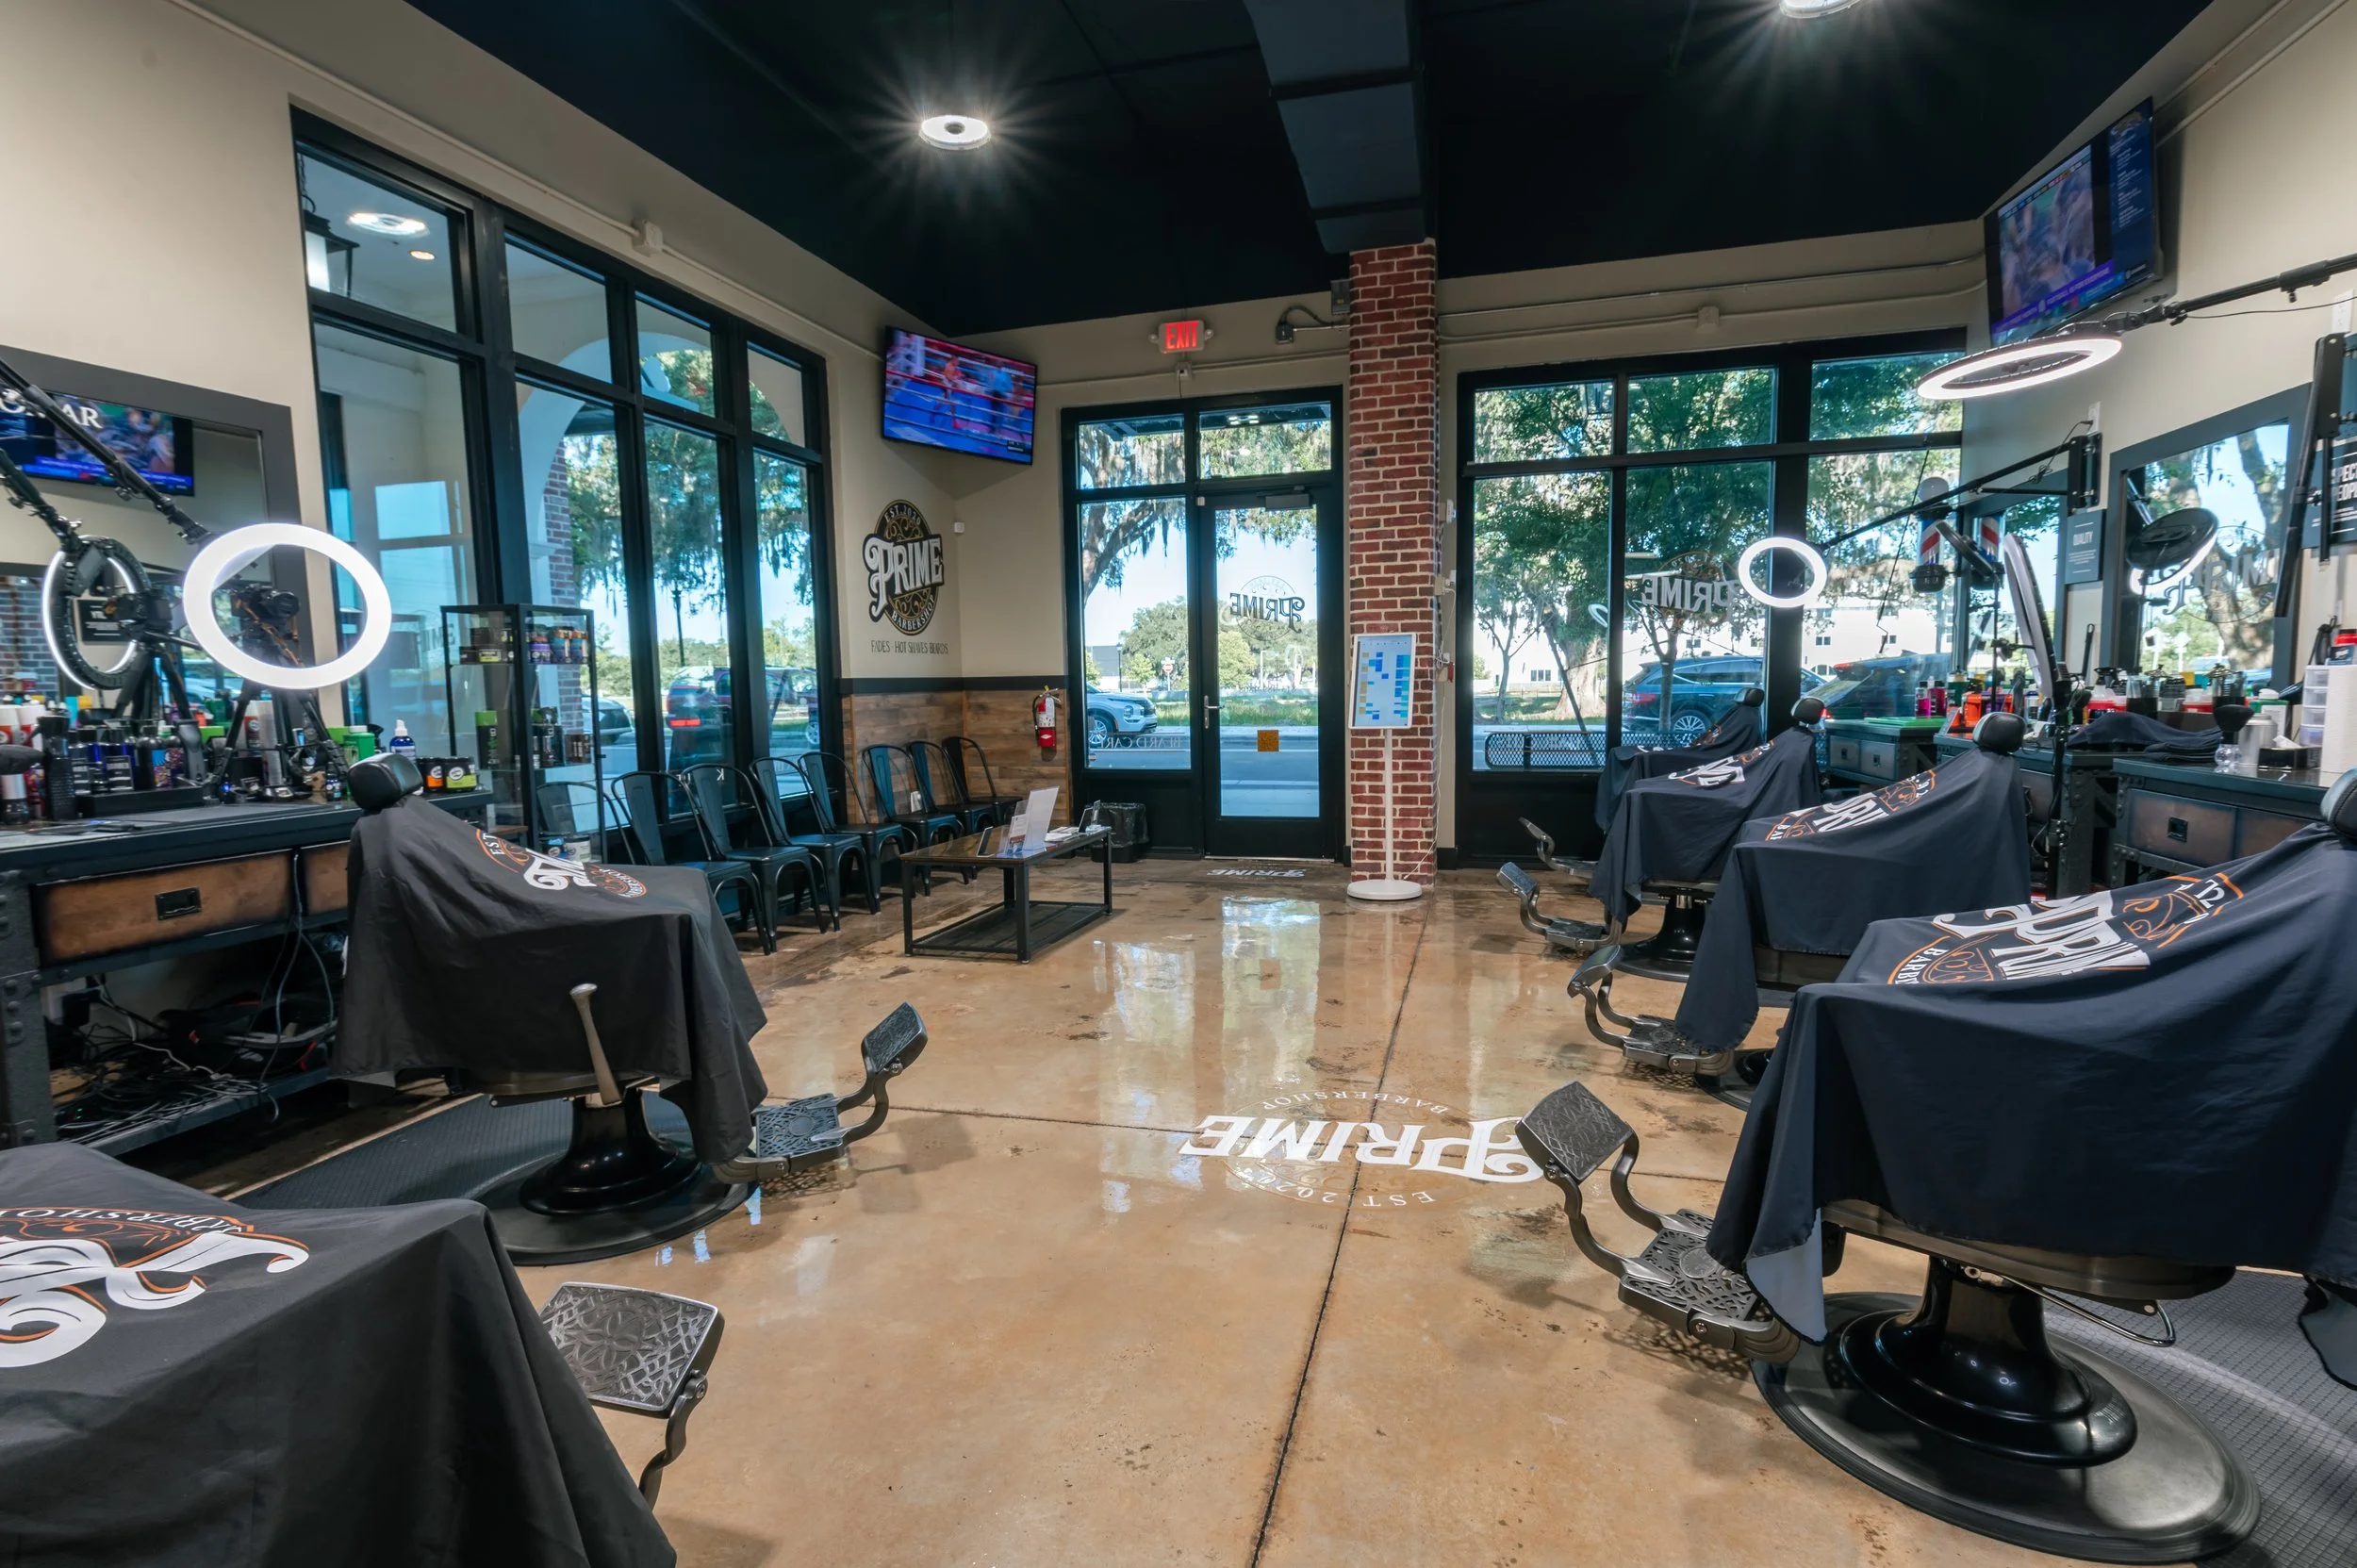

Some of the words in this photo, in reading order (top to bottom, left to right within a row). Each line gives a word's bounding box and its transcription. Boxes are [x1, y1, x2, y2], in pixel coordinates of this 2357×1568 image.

[1165, 321, 1199, 350] EXIT
[865, 536, 943, 618] PRIME
[891, 594, 936, 631] BARBERSHOP
[871, 640, 890, 653] FADES
[895, 641, 906, 653] HOT
[1261, 1091, 1449, 1114] BARBERSHOP
[1178, 1115, 1544, 1183] PRIME
[1258, 1172, 1339, 1204] 2020
